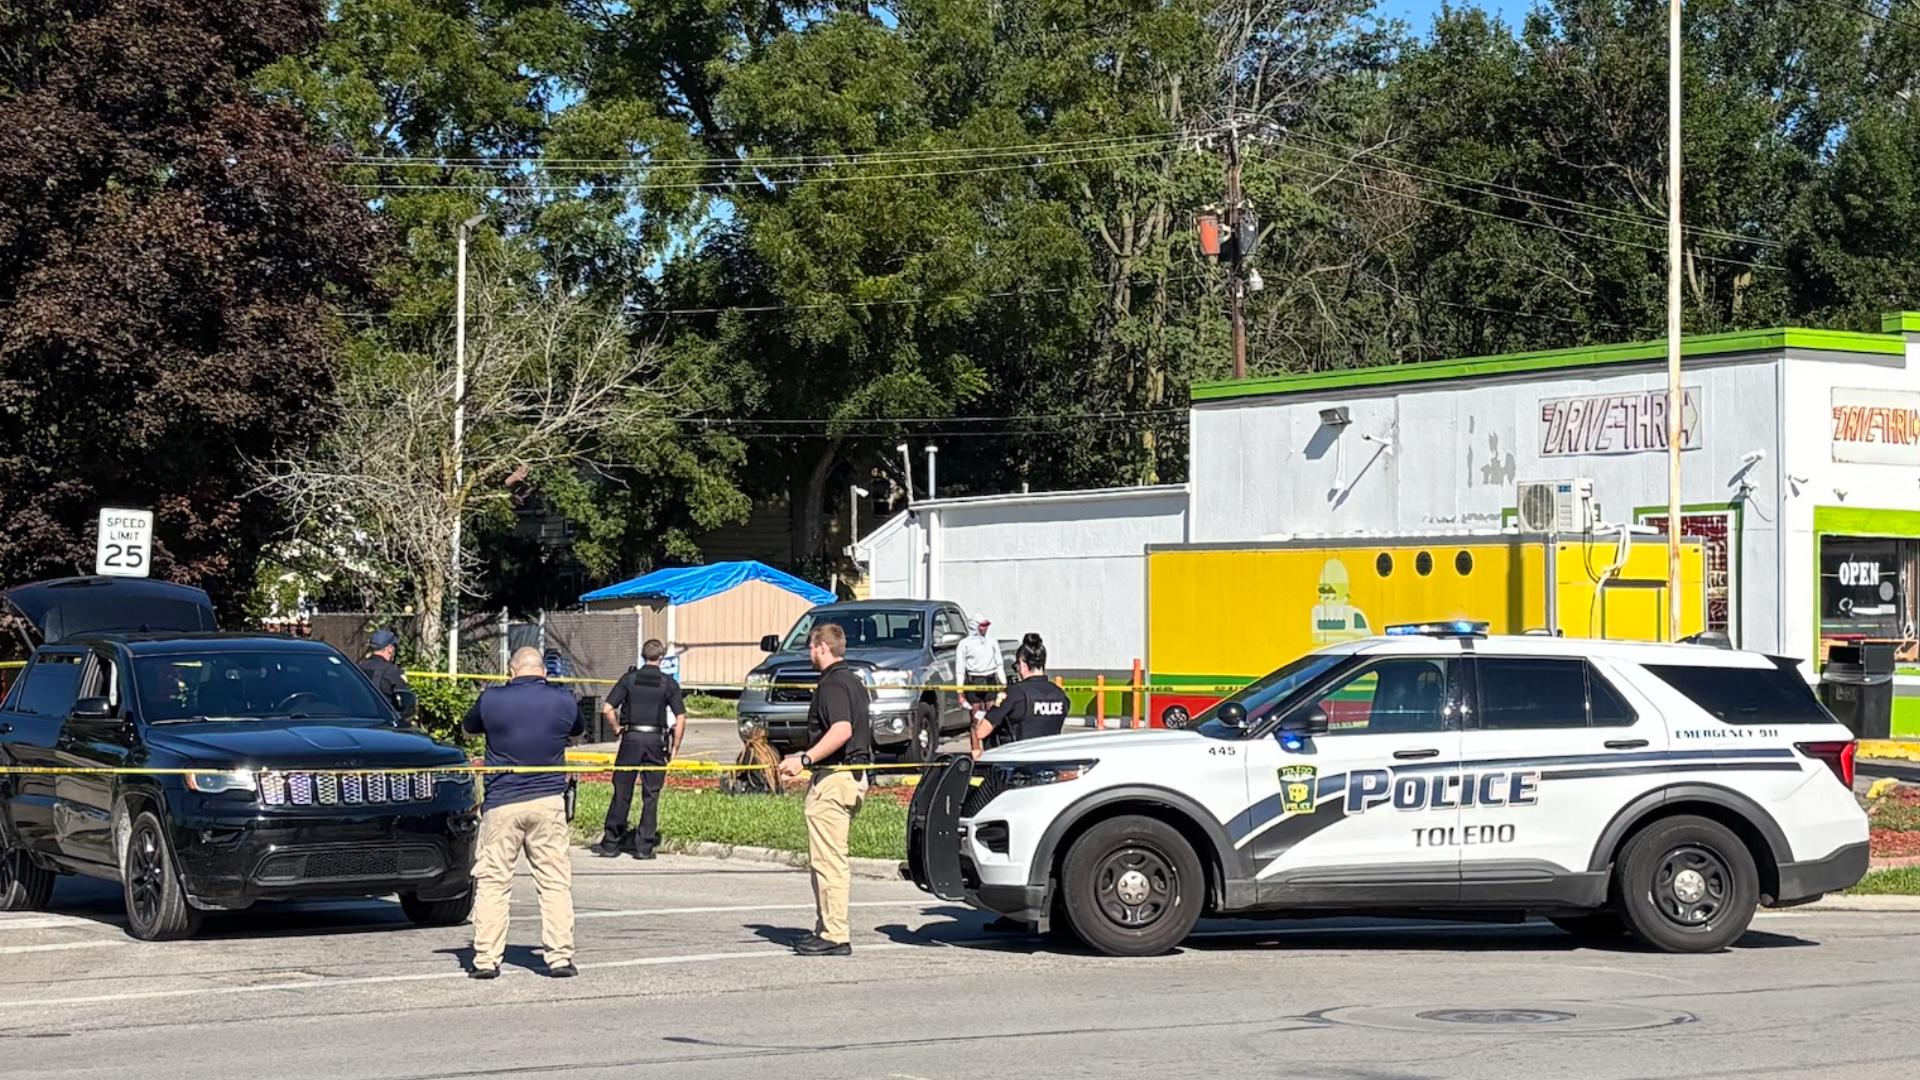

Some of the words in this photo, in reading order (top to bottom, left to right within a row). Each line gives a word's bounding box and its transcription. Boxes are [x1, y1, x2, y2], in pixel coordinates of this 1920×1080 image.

[107, 517, 146, 528] SPEED
[110, 531, 139, 540] LIMIT
[104, 543, 143, 568] 25
[1839, 561, 1880, 586] OPEN
[1033, 702, 1063, 715] POLICE
[1675, 729, 1753, 739] EMERGENCY
[1759, 729, 1778, 738] 911
[1208, 746, 1236, 756] 445
[1345, 767, 1540, 813] POLICE
[1412, 824, 1515, 847] TOLEDO
